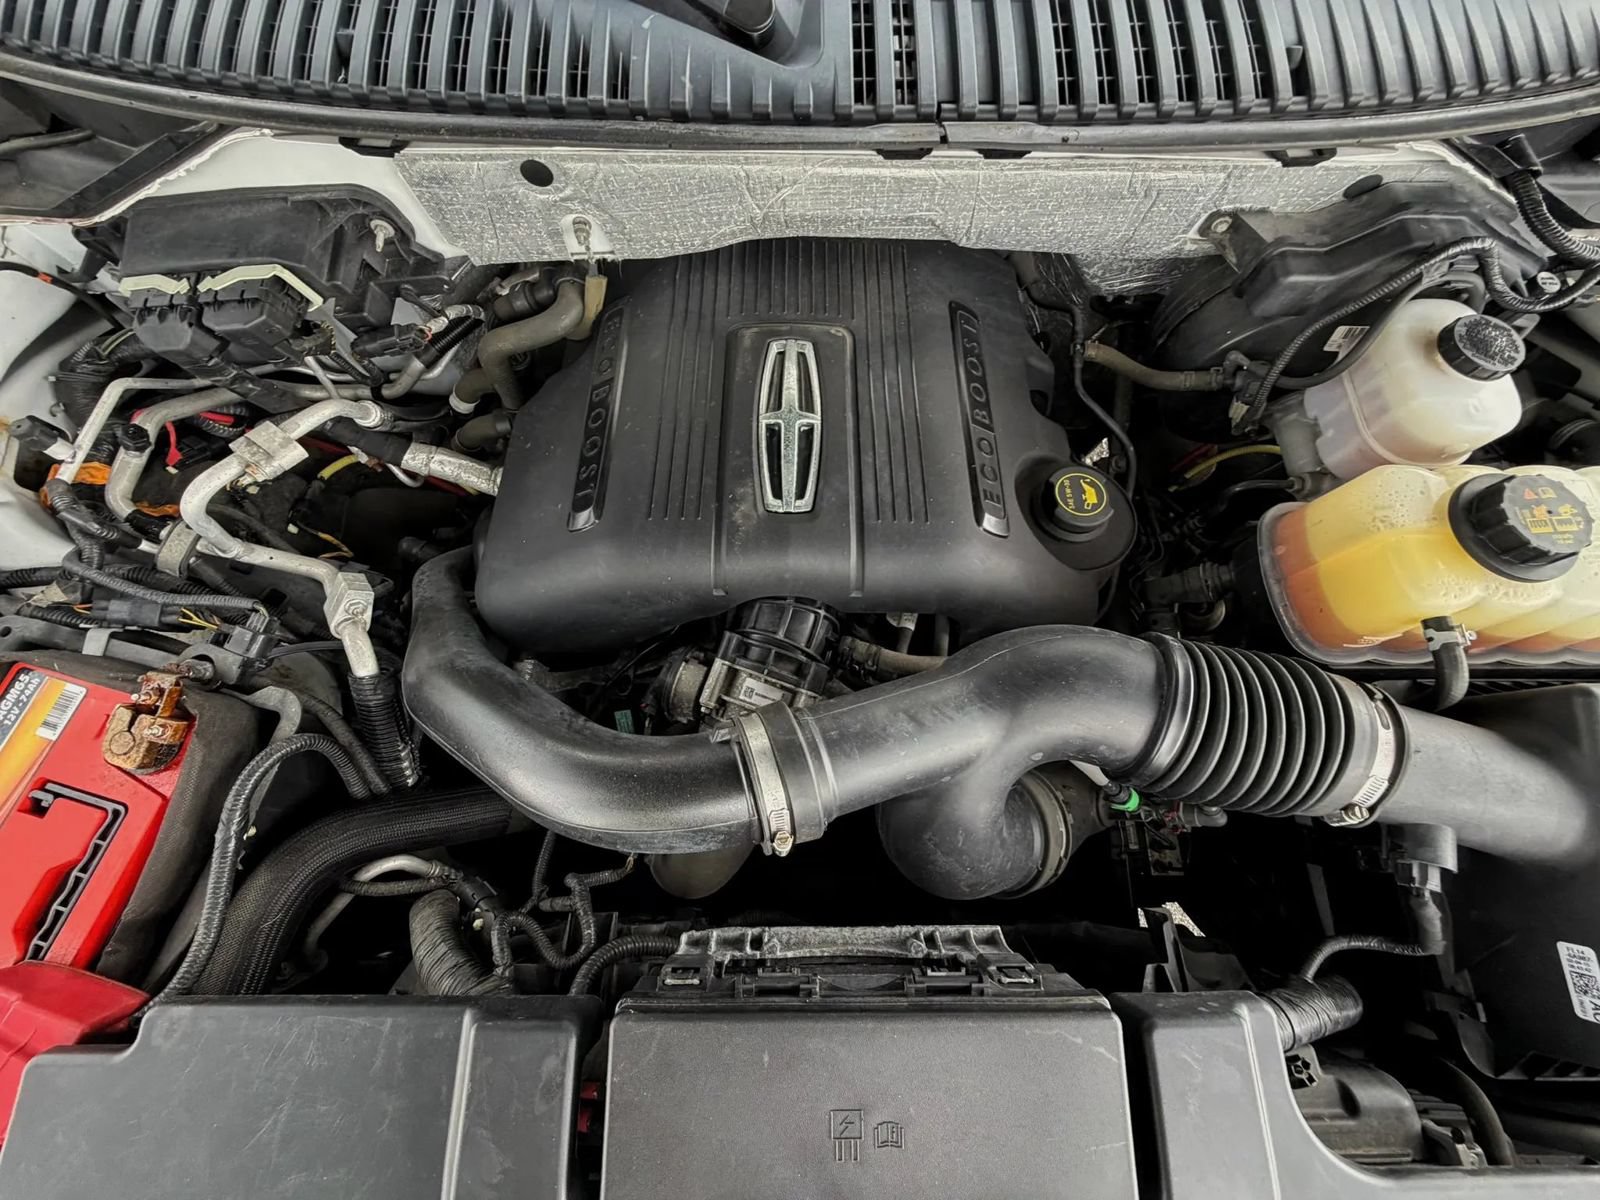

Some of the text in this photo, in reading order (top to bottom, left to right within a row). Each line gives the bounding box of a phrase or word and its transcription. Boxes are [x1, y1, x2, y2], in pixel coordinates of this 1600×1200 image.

[575, 317, 620, 500] ECOBOOST
[961, 320, 1003, 508] ECOBOOST
[3, 706, 20, 726] 12V
[19, 677, 41, 704] 74Ah
